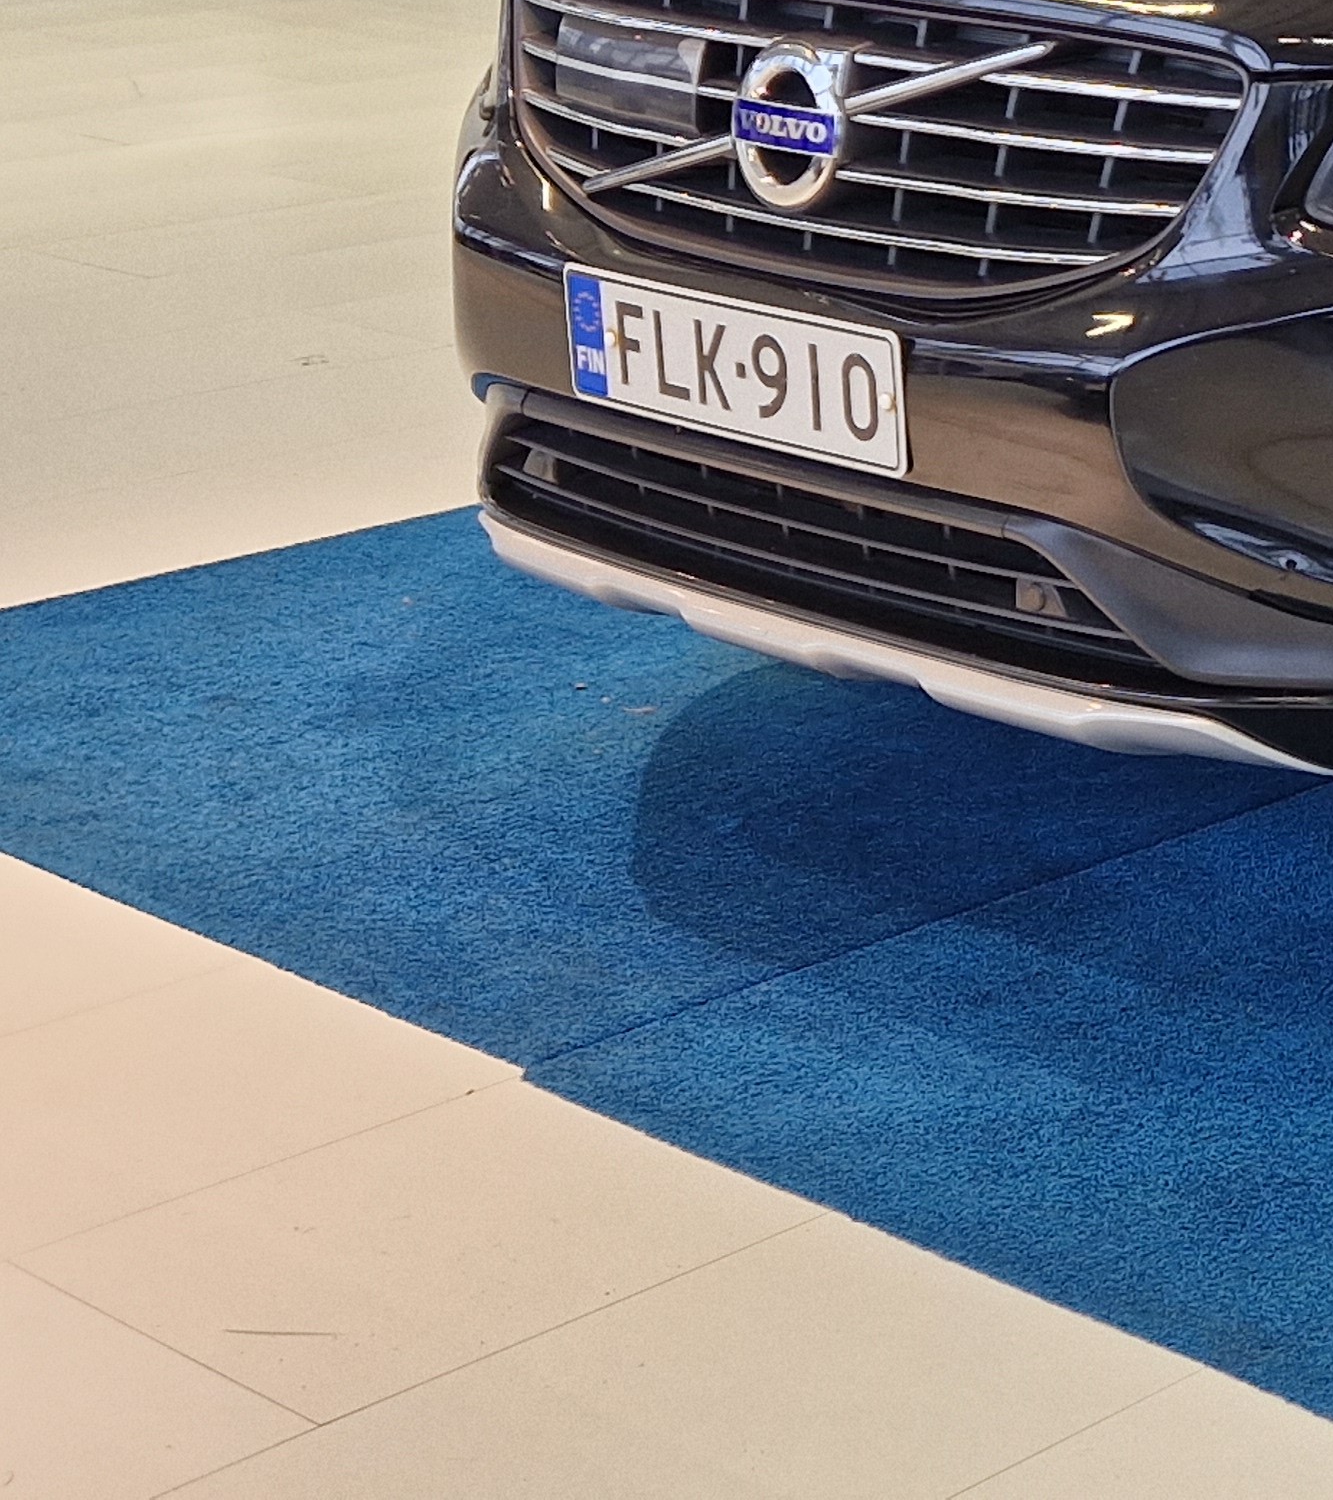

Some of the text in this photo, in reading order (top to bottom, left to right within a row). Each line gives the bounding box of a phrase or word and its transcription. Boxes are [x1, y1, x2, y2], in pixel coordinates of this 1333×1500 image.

[740, 108, 827, 143] VOLVO
[576, 345, 606, 375] FIN
[615, 300, 880, 441] FLK-910
